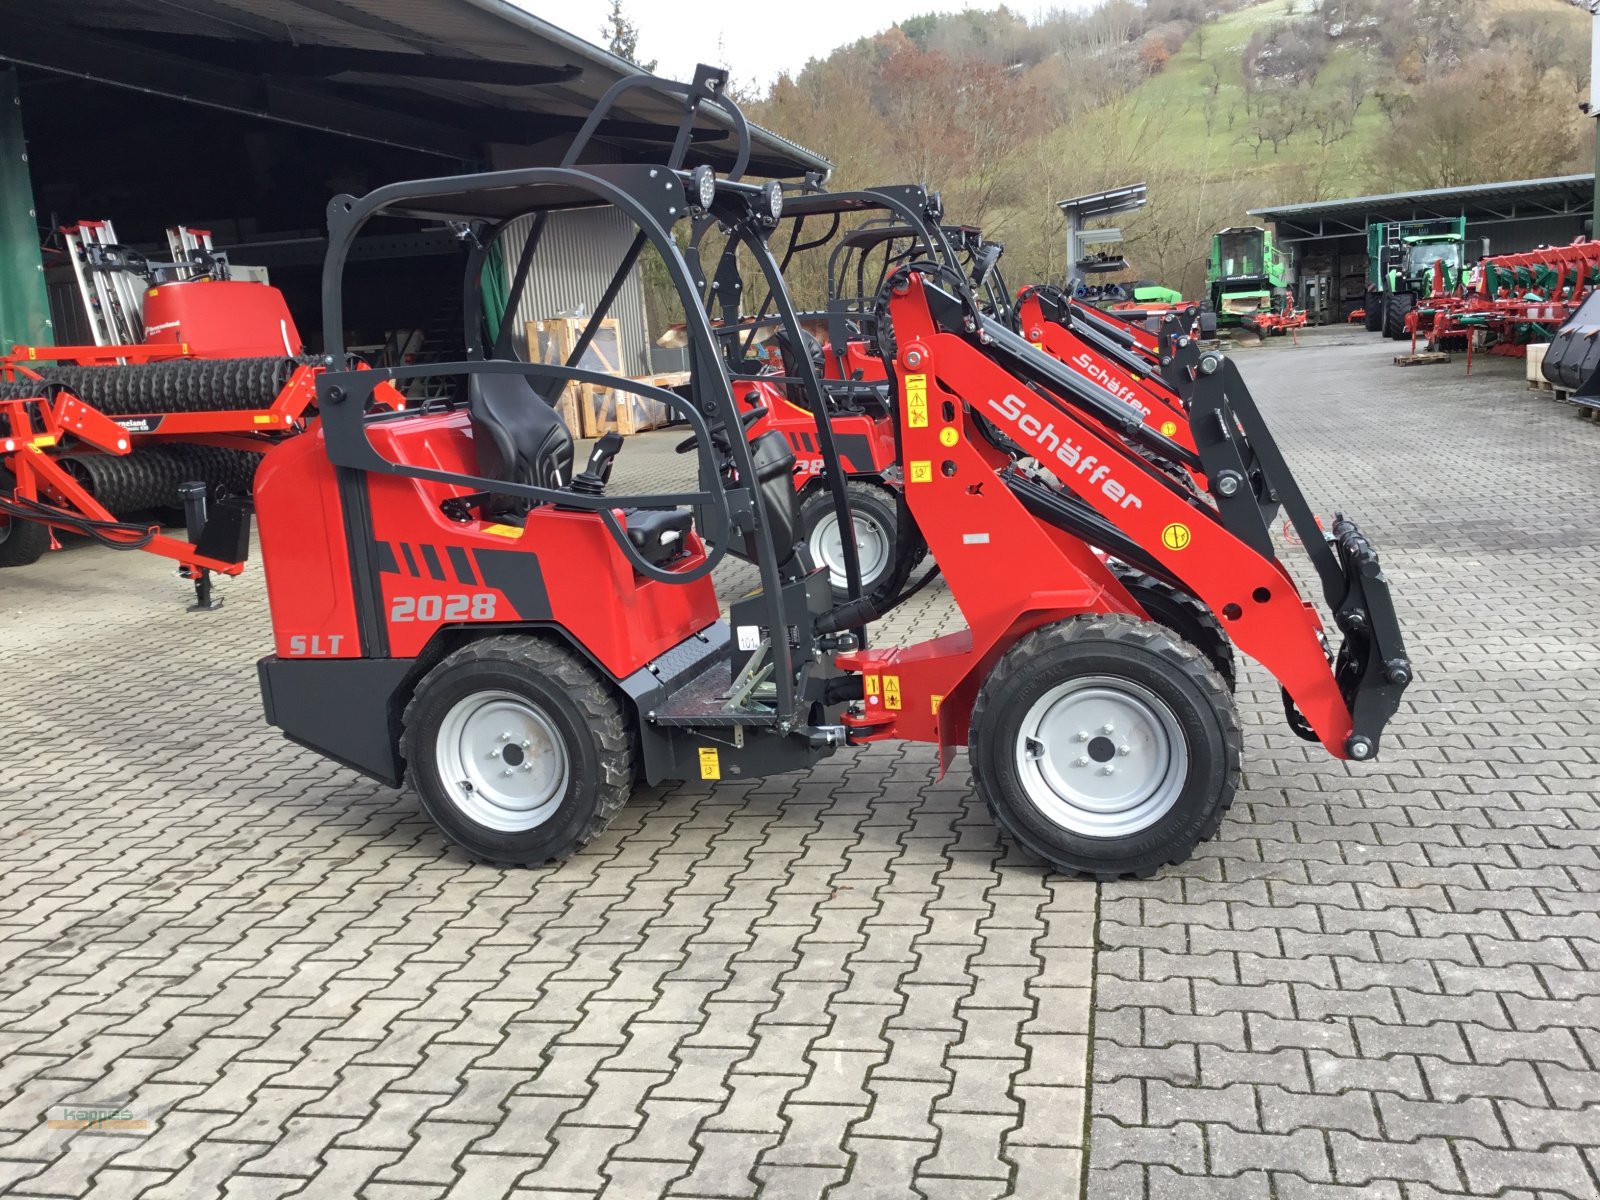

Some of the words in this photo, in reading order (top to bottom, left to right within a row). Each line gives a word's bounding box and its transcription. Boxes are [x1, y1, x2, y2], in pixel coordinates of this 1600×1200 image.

[988, 394, 1142, 509] Schäffer
[391, 593, 497, 622] 2028
[290, 635, 344, 655] SLT
